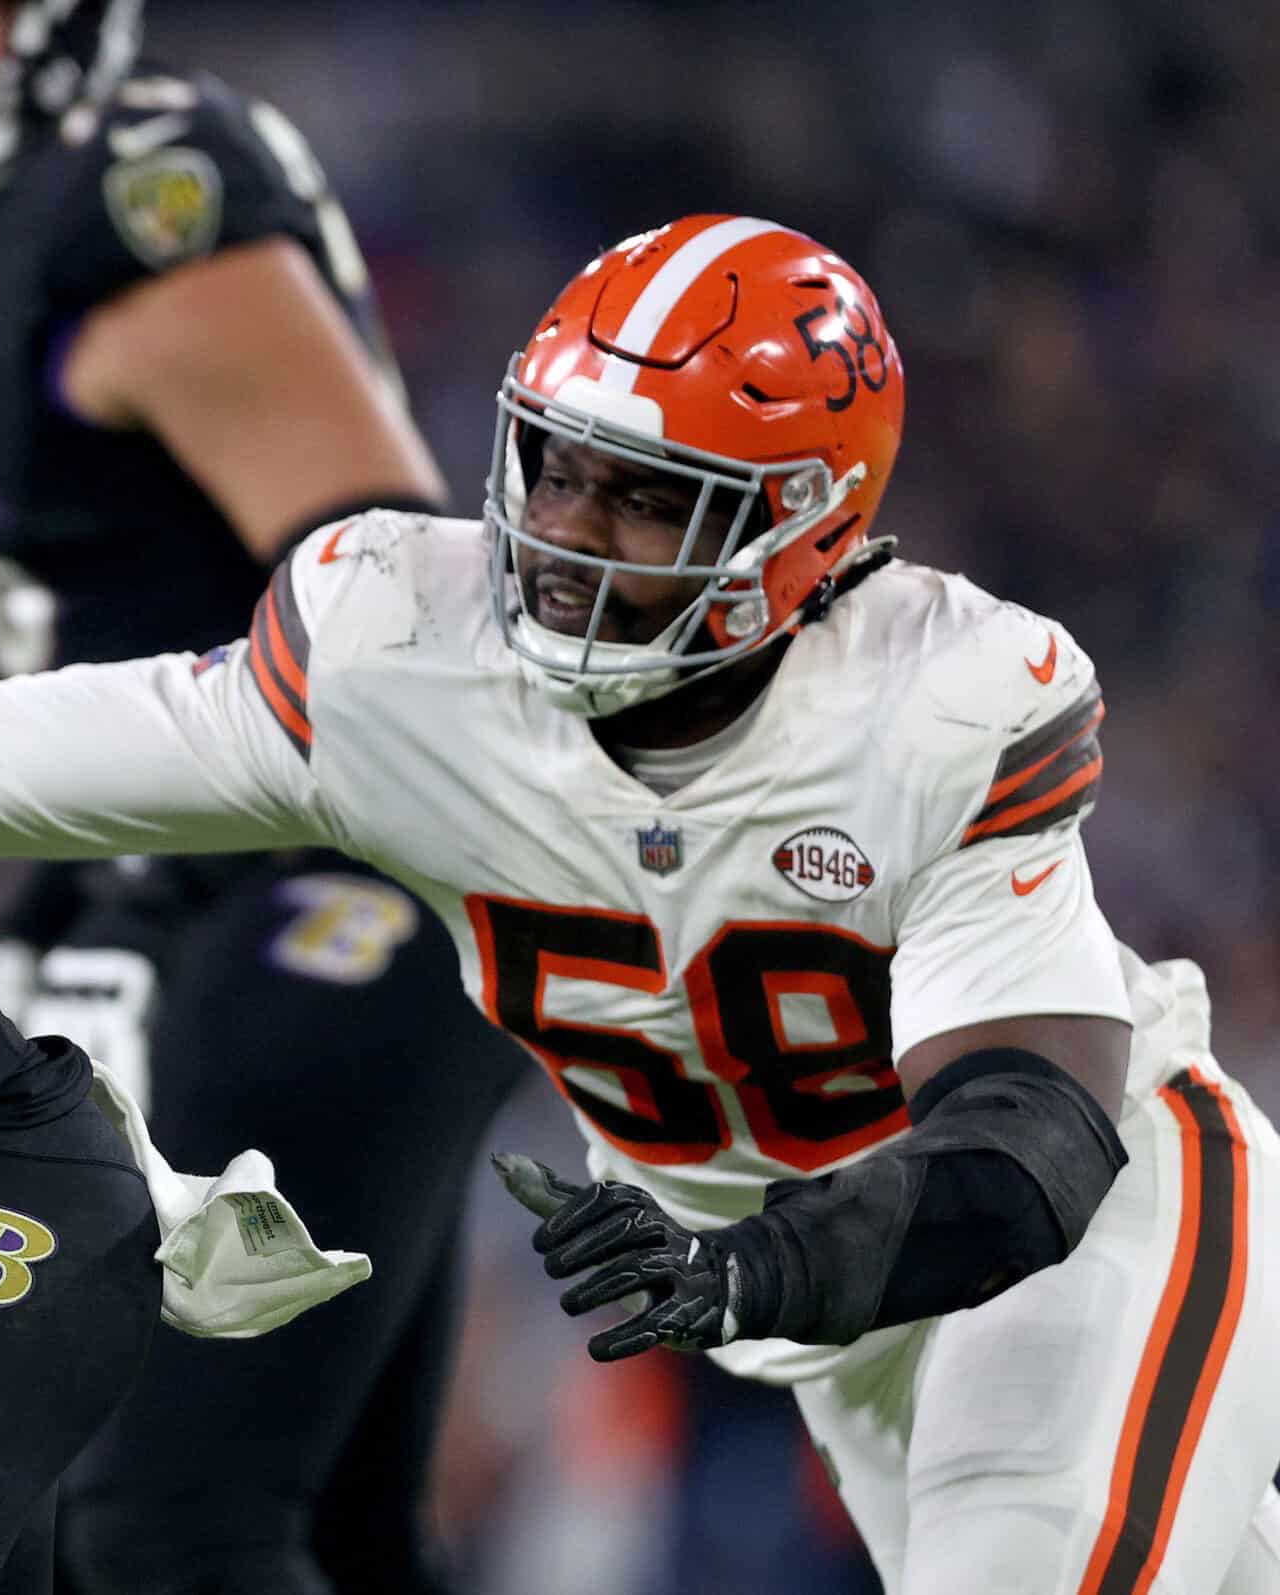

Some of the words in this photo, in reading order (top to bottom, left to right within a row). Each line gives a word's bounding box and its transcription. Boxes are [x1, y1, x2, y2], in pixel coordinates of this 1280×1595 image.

[793, 295, 888, 412] 58
[641, 845, 677, 867] NFL
[797, 843, 857, 889] 1946
[463, 892, 912, 1172] 58
